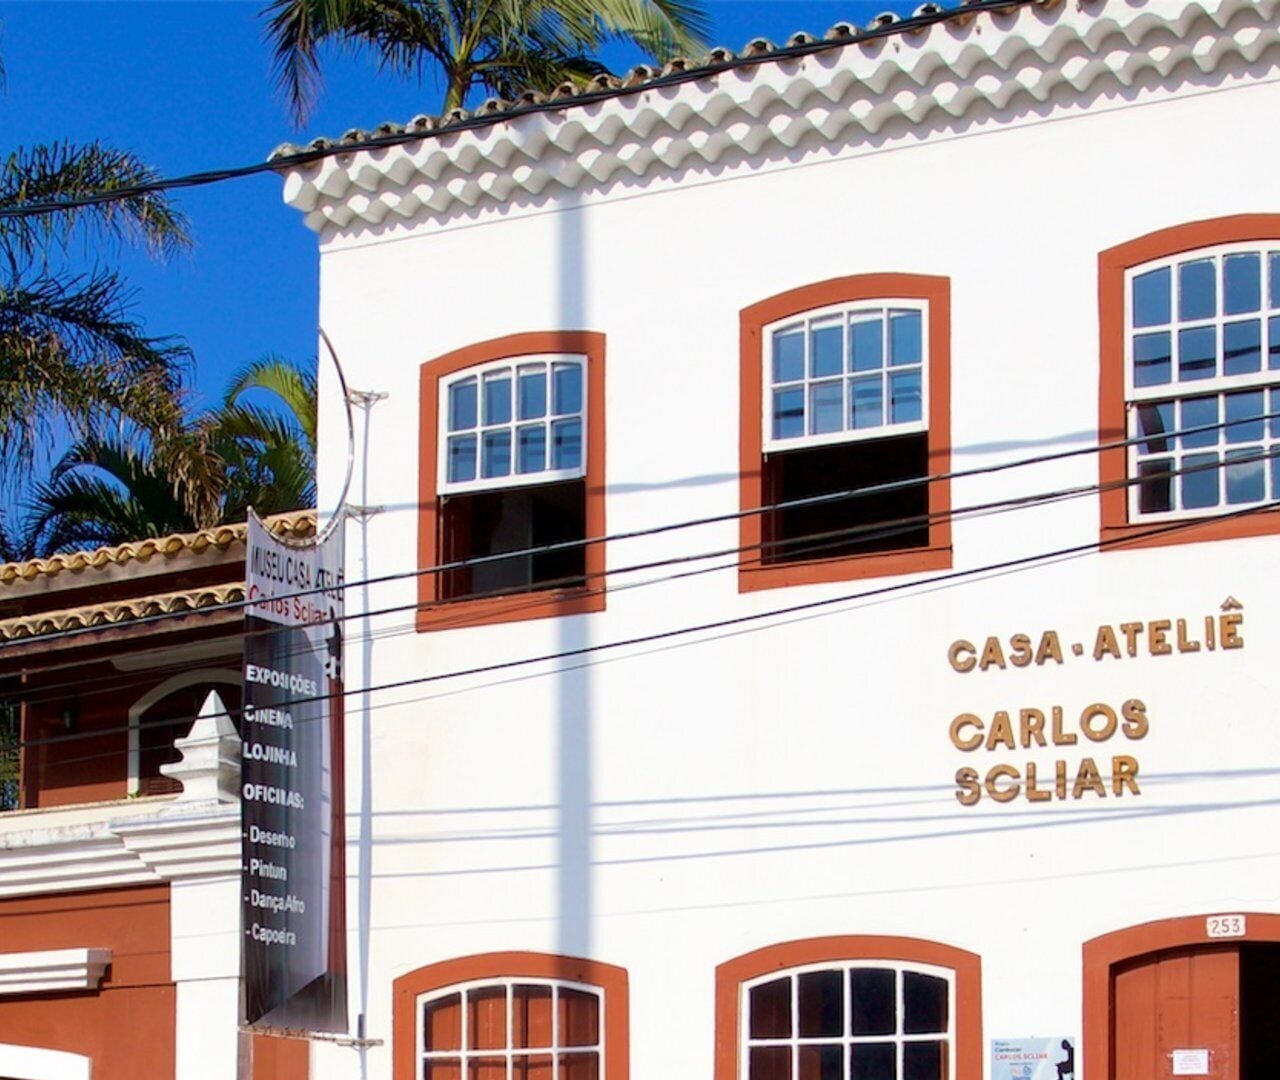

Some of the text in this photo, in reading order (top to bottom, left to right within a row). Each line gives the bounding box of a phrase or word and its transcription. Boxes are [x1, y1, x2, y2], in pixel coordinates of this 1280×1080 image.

[250, 544, 285, 584] MUSEU
[286, 555, 311, 590] CASA
[947, 595, 1245, 674] CASA ATELIÊ
[245, 664, 318, 698] EXPOSIÇÕES
[949, 698, 1149, 753] CARLOS
[242, 741, 298, 768] LOJINHA
[954, 754, 1141, 807] SCLIAR
[1210, 917, 1241, 935] 253
